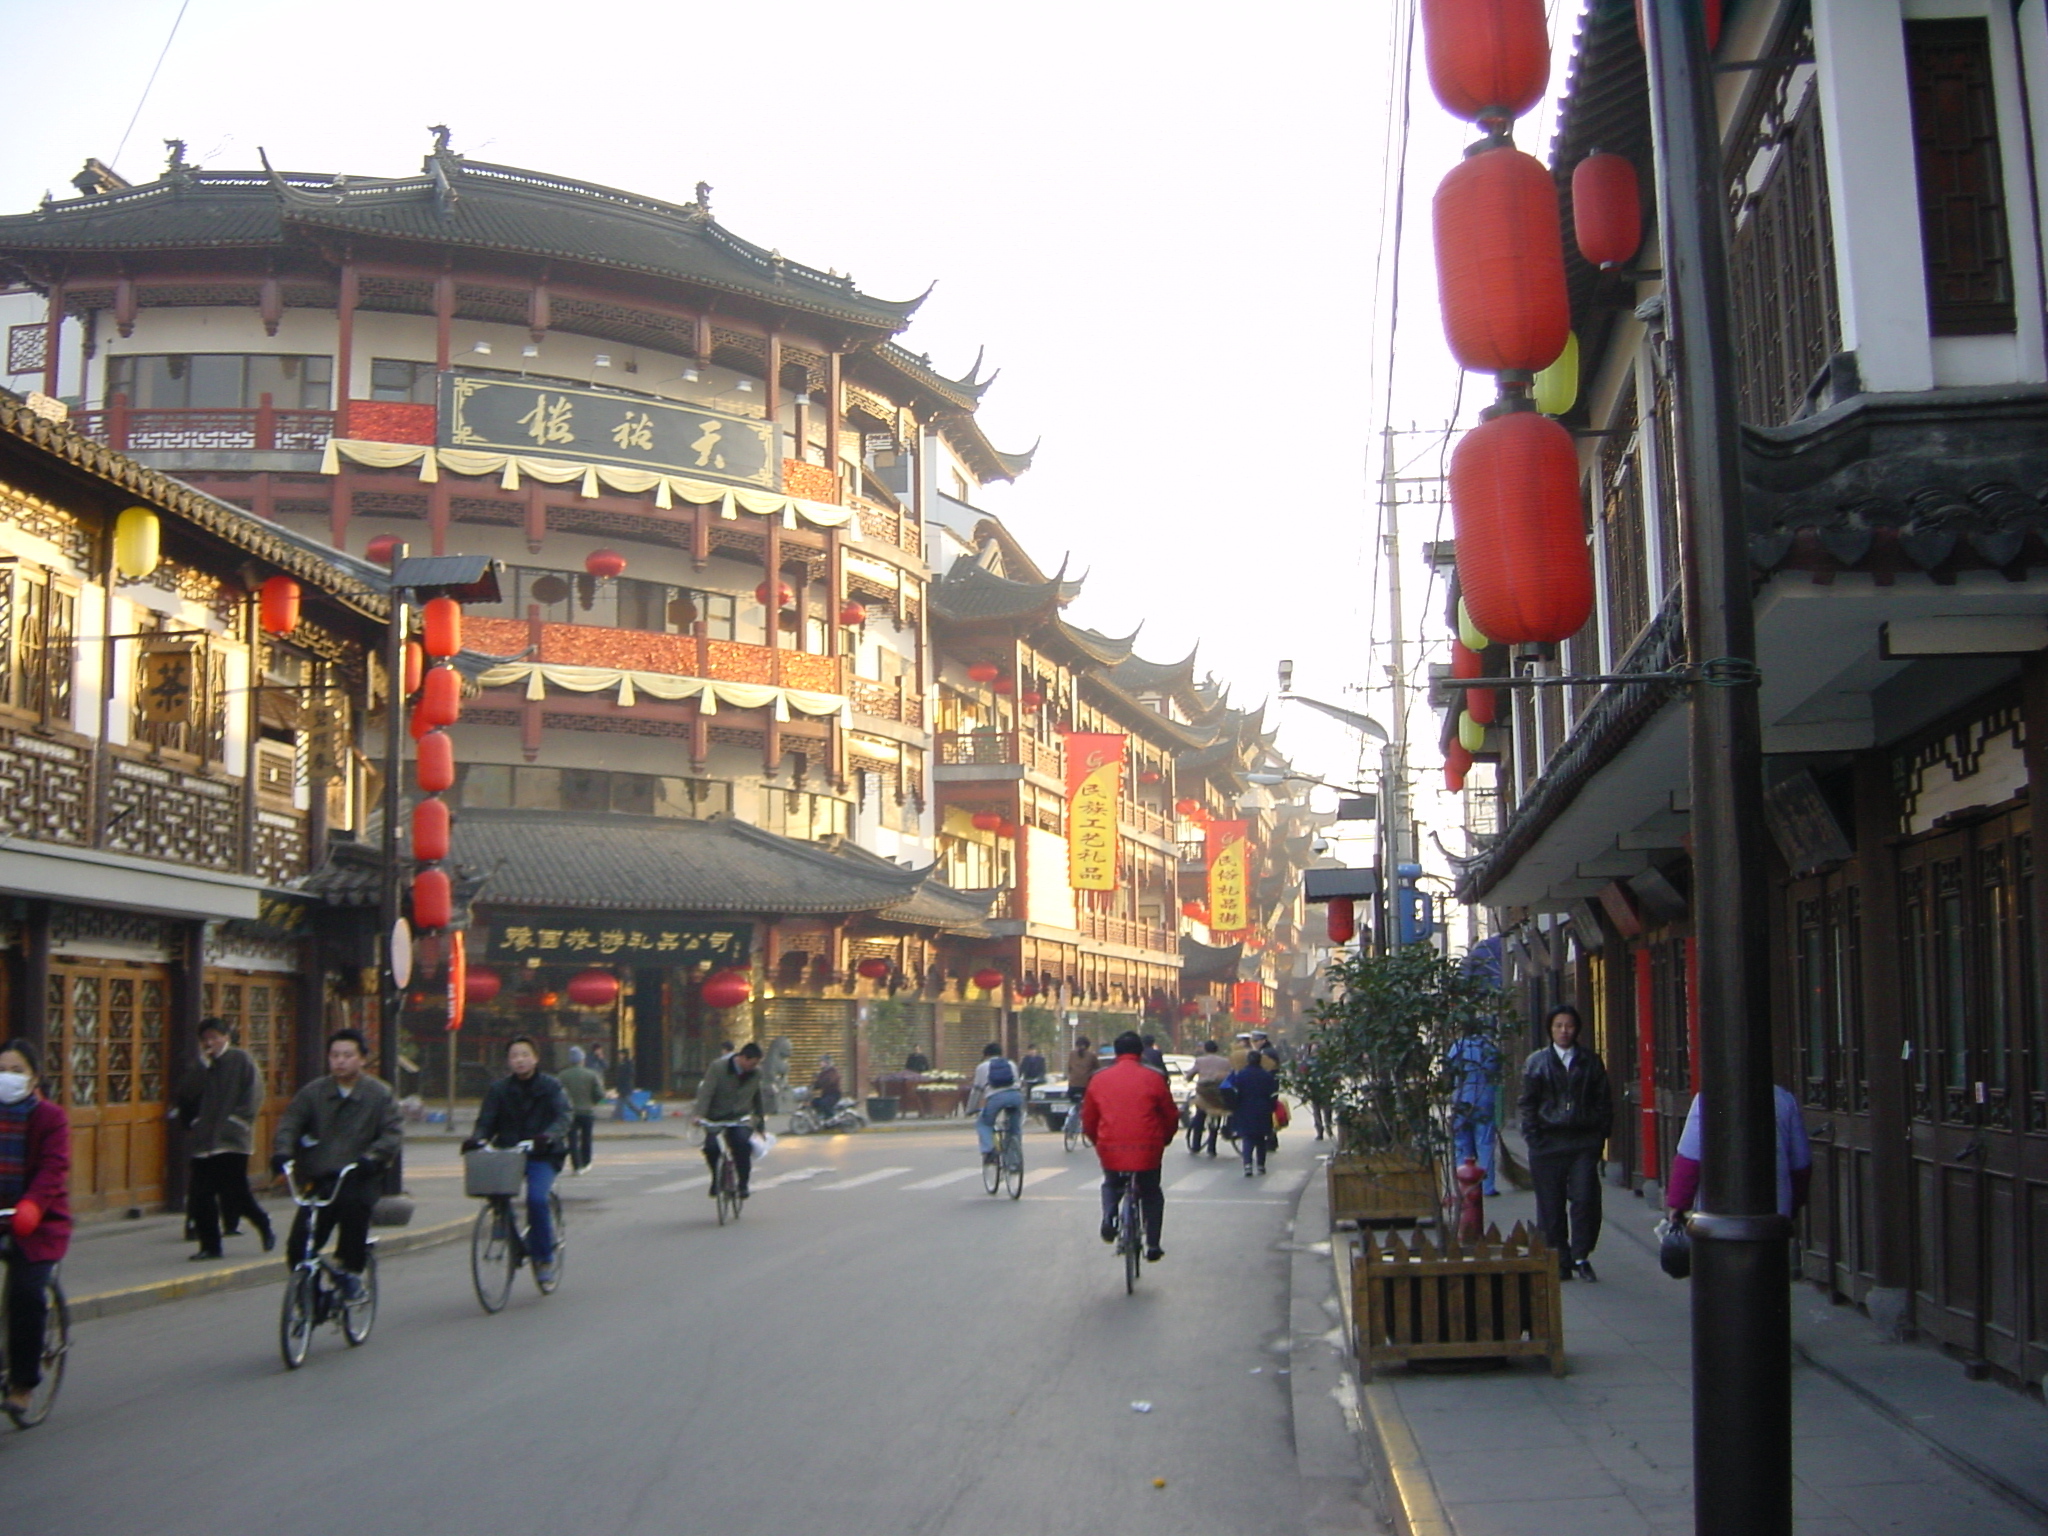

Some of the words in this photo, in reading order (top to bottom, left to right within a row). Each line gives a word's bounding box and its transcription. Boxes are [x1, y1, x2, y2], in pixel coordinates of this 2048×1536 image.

[1078, 783, 1107, 880] 民族工艺礼品
[1217, 855, 1240, 925] 民俗礼品街
